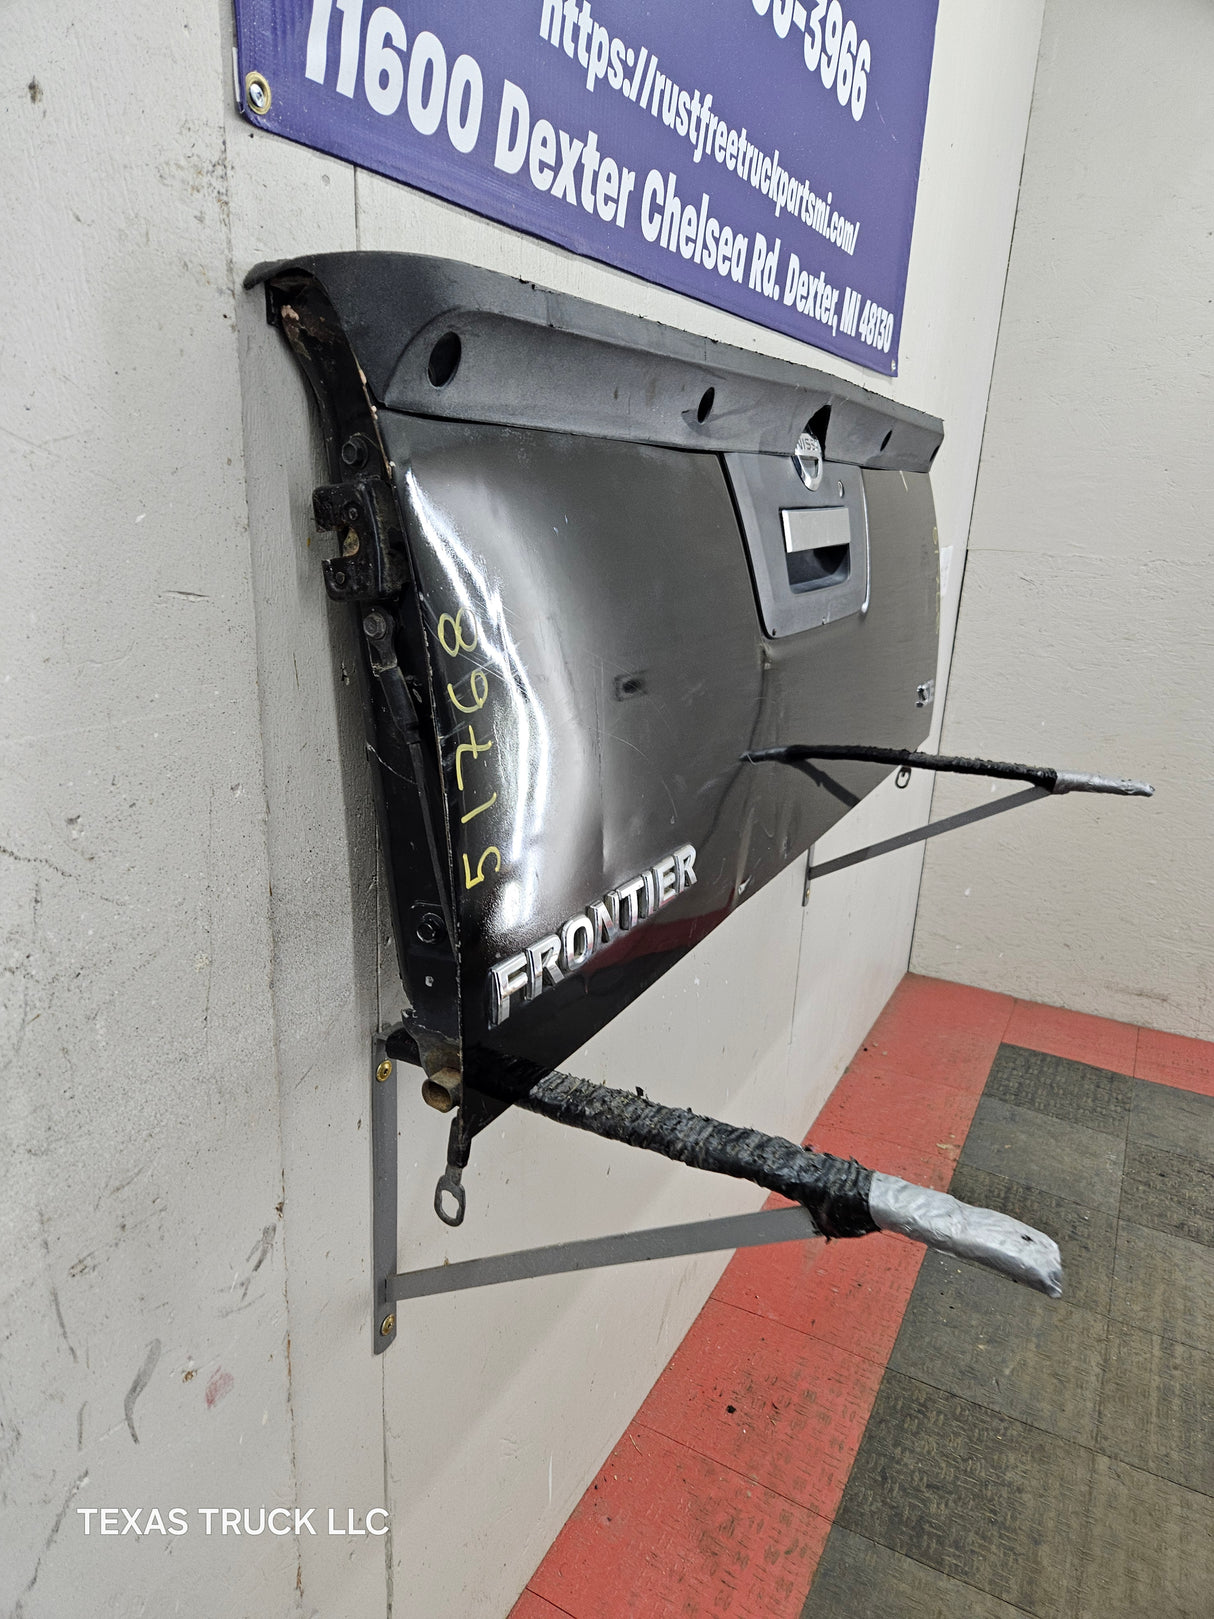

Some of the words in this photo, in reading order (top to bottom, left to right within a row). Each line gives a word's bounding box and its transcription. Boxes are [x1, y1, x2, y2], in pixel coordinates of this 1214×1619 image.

[305, 0, 484, 154] 11600
[494, 79, 635, 228] Dexter
[641, 169, 748, 283] Chelsea
[749, 232, 781, 300] Rd.
[784, 253, 839, 337] Dexter,
[840, 287, 862, 337] MI
[859, 299, 894, 353] 48130
[540, 0, 860, 256] https://rustfreetruckpartsmi.com/
[438, 607, 501, 890] 51768
[489, 842, 698, 1028] FRONTIER
